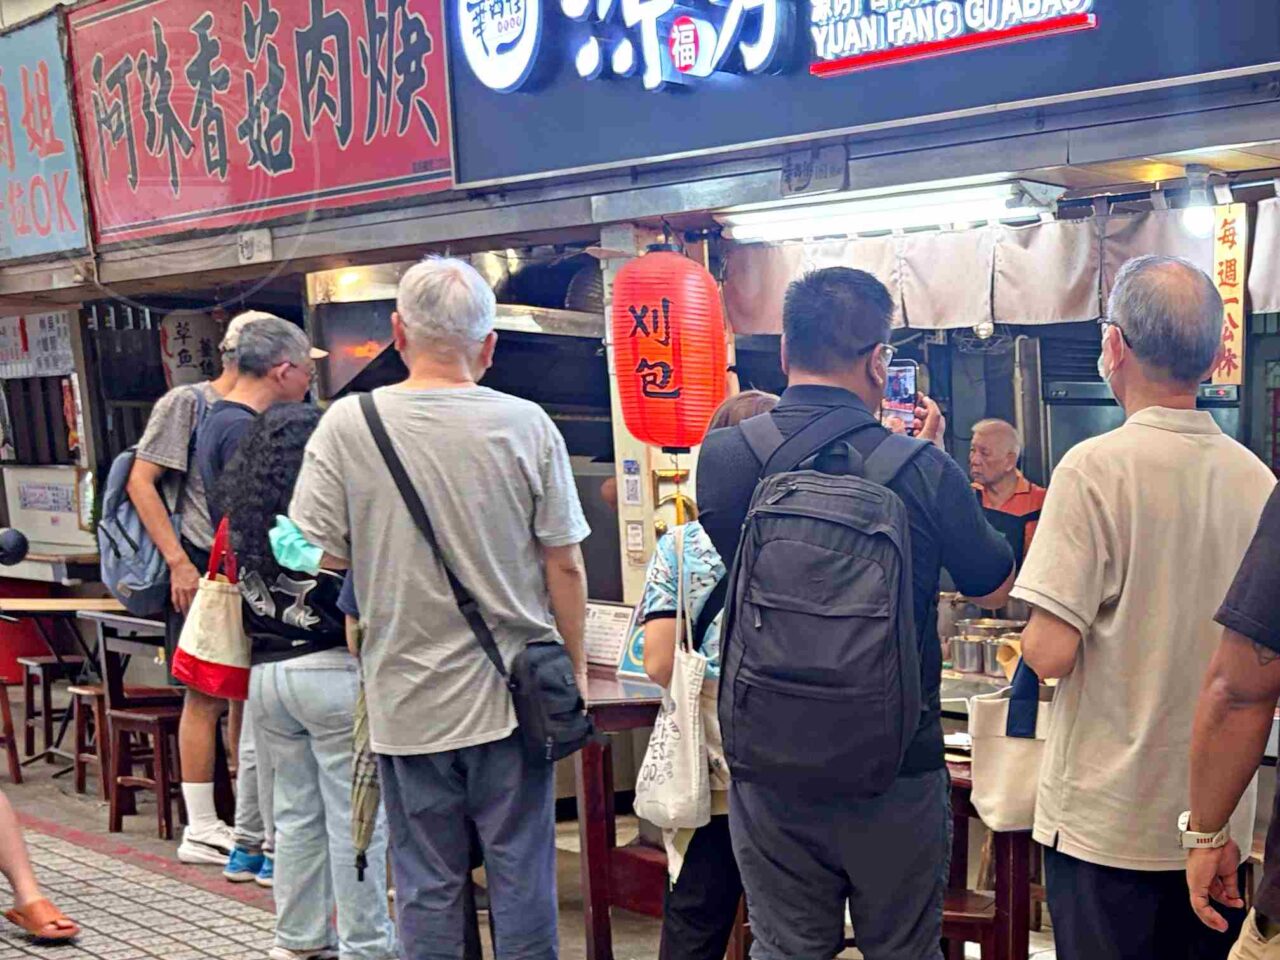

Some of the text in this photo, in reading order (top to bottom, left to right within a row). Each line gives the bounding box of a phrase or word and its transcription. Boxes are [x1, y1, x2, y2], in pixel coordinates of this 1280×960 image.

[672, 24, 697, 68] 福
[811, 14, 879, 58] YUAN
[887, 1, 959, 45] FANG
[628, 297, 683, 399] 刈包
